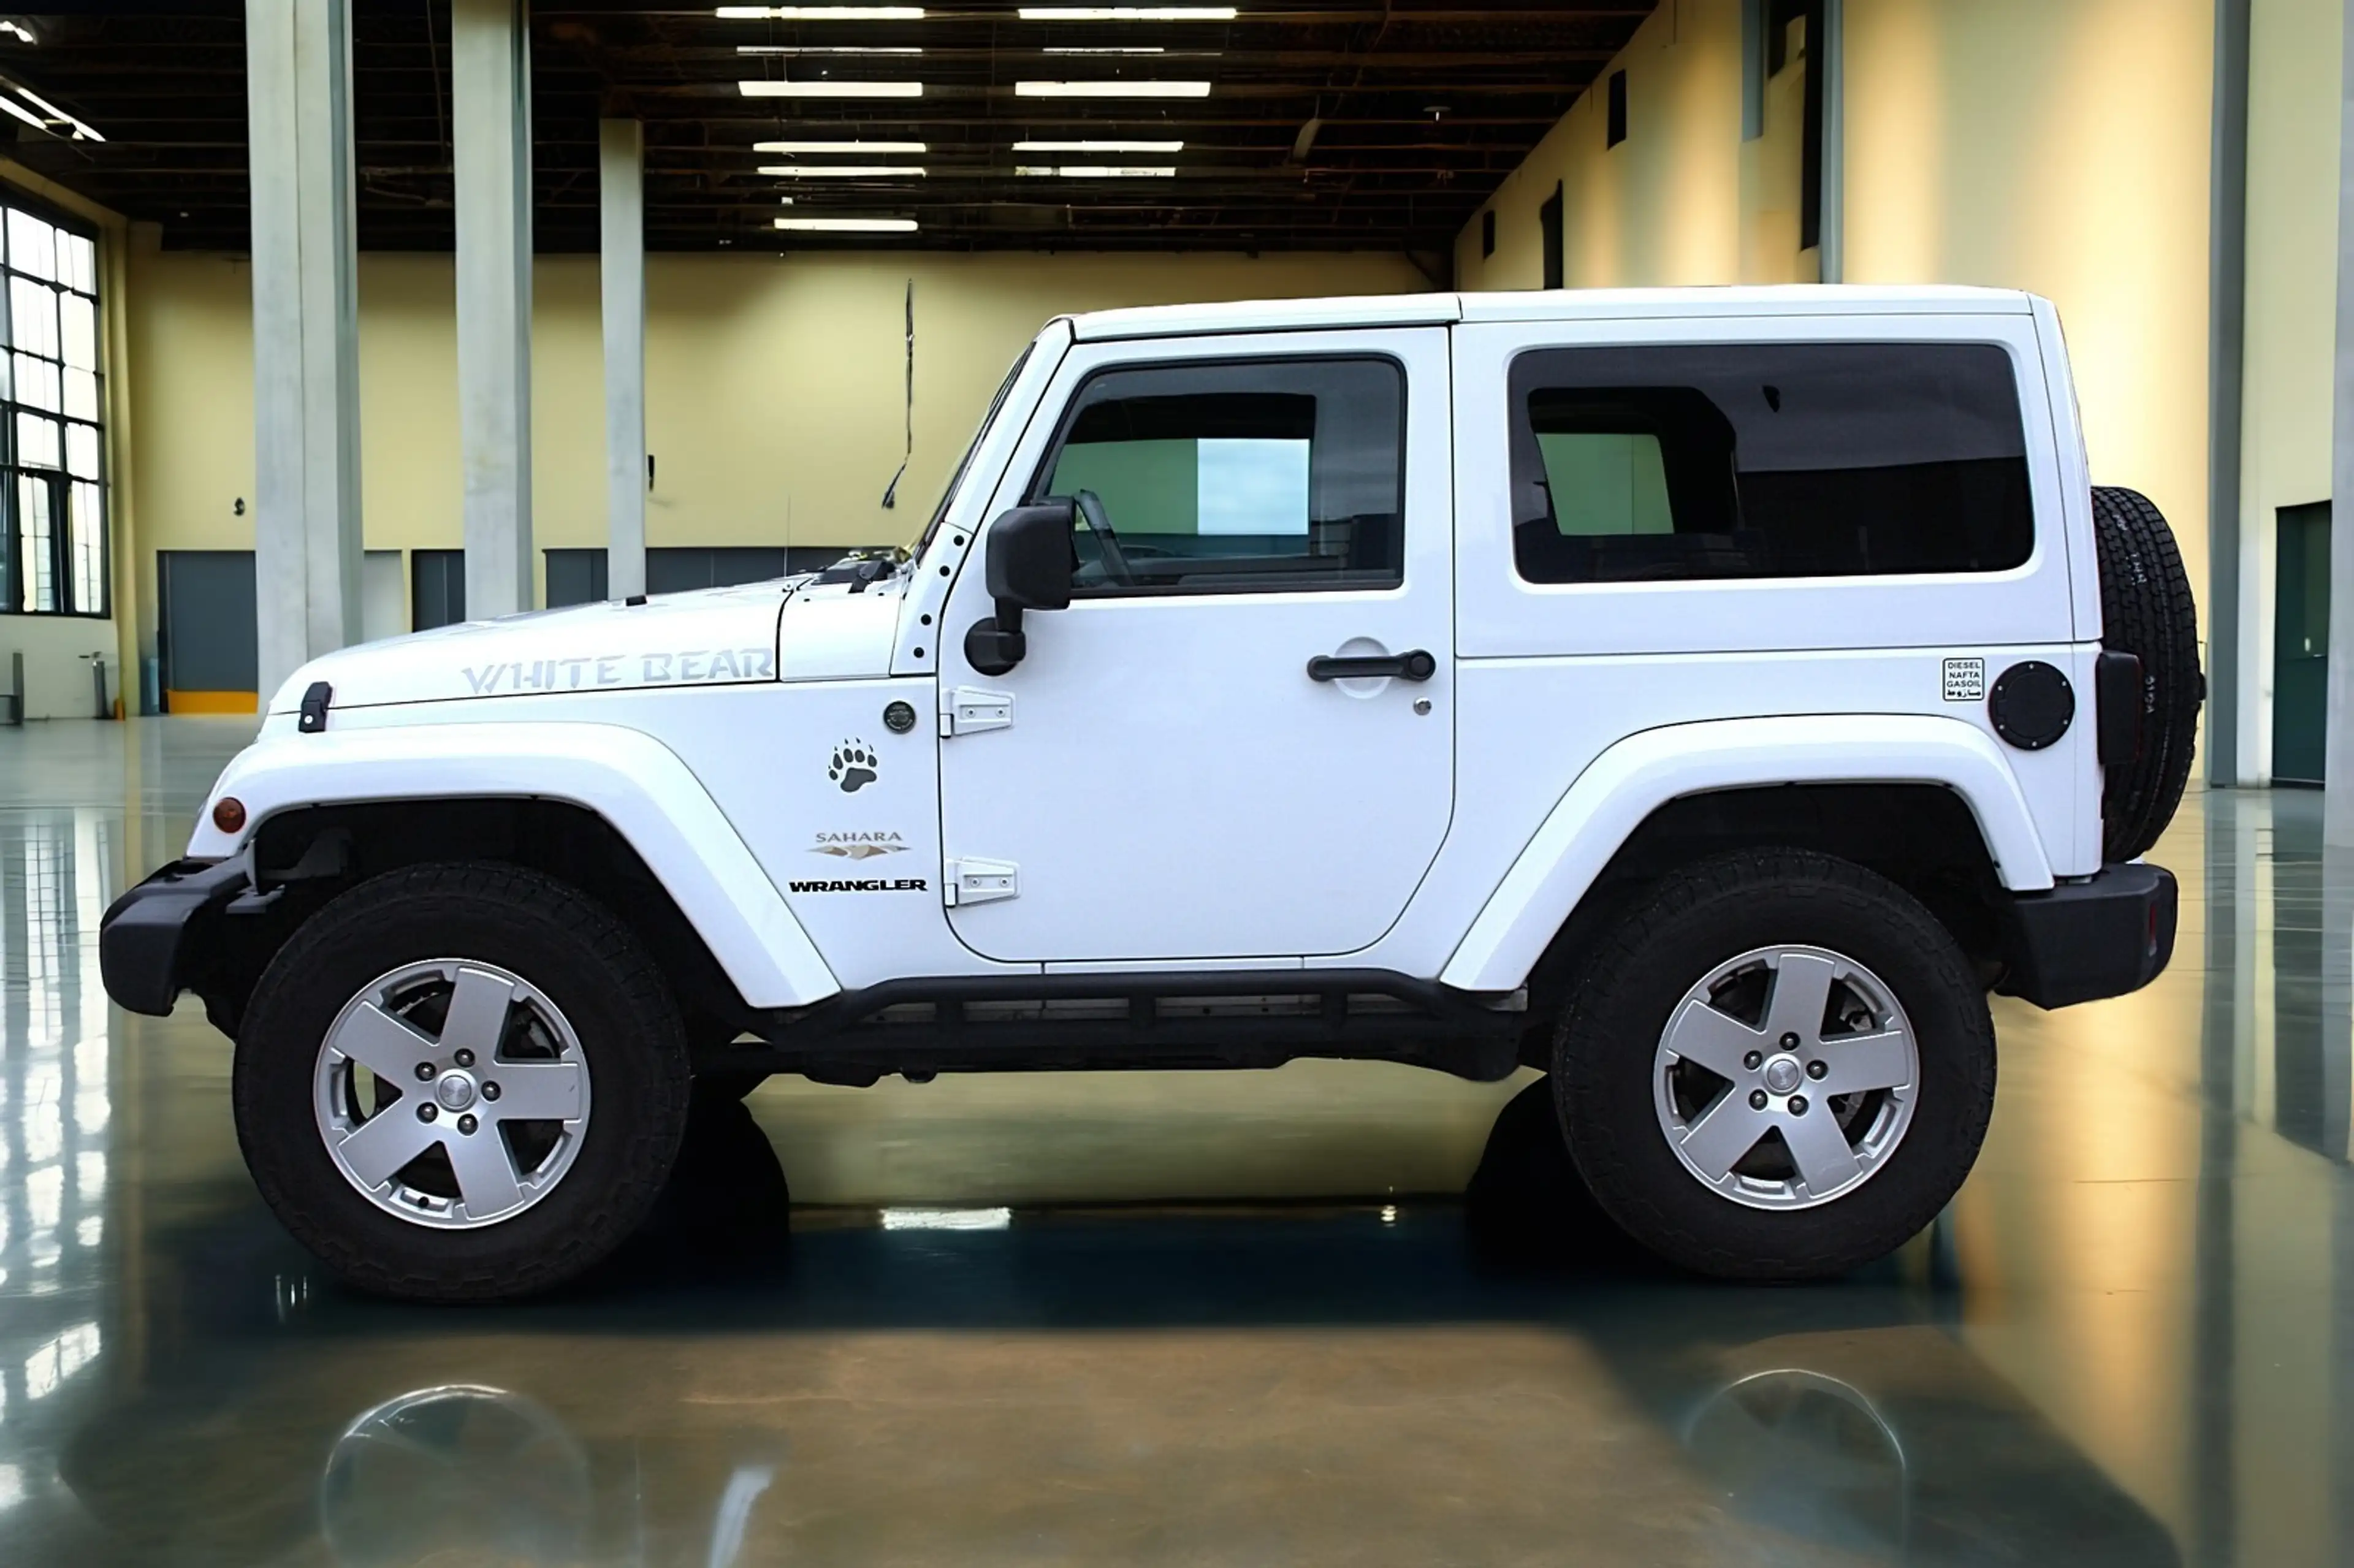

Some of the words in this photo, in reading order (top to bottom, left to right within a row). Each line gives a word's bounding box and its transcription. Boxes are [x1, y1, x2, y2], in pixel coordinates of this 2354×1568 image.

[461, 654, 626, 695] WHITE
[640, 647, 774, 682] BEAR
[816, 832, 902, 843] SAHARA
[789, 879, 928, 892] WRANGLER
